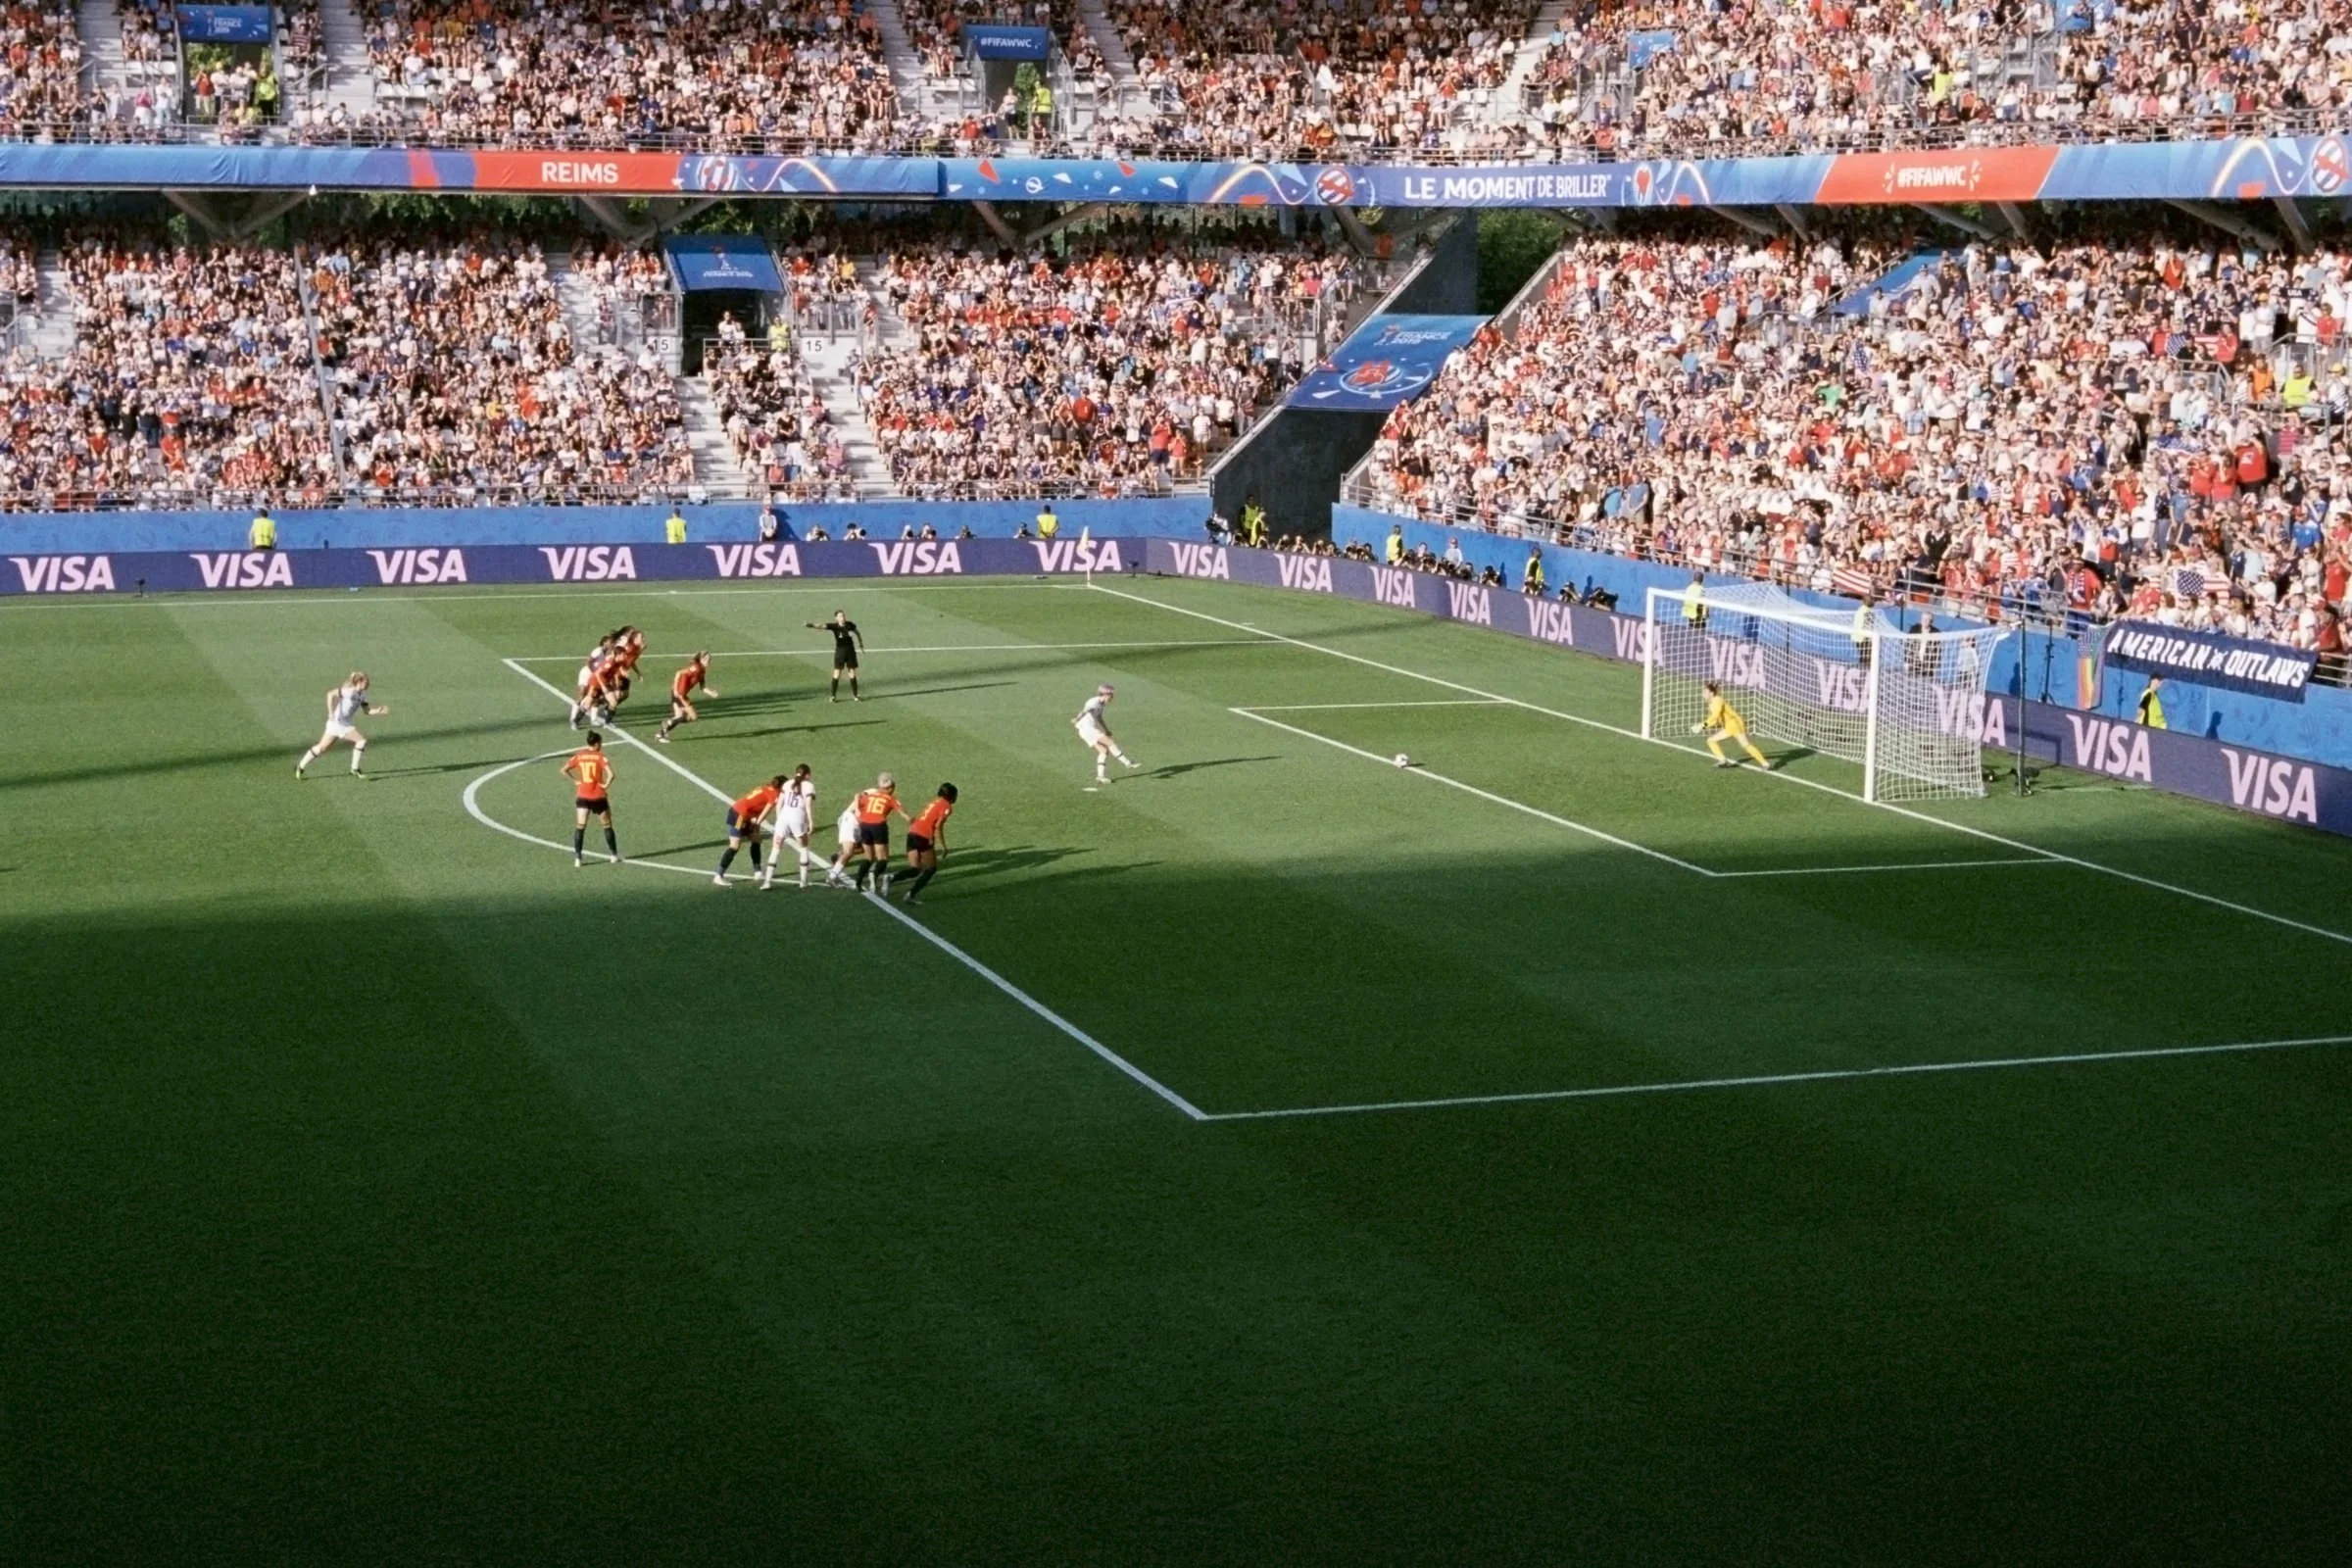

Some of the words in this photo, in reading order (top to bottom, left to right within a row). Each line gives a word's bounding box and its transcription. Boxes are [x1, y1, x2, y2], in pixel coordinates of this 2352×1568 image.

[980, 37, 1032, 48] #FIFAWWC
[541, 161, 619, 183] REIMS
[1404, 176, 1437, 199] LE
[1444, 175, 1536, 200] MOMENT
[1537, 174, 1555, 197] DE
[1897, 165, 1967, 188] #FIFAWWC
[807, 340, 823, 352] 15
[189, 553, 294, 587] VISA
[366, 549, 467, 584] VISA
[538, 547, 636, 579] VISA
[706, 544, 801, 577] VISA
[867, 542, 962, 574] VISA
[1029, 540, 1122, 572] VISA
[1168, 542, 1230, 579] VISA
[1274, 553, 1334, 592] VISA
[9, 557, 115, 591] VISA
[1369, 565, 1415, 608] VISA
[1446, 580, 1491, 625] VISA
[1525, 597, 1573, 645] VISA
[1705, 637, 1765, 689] VISA
[2107, 629, 2212, 670] AMERICAN
[2223, 649, 2311, 688] OUTLAWS
[1931, 684, 2006, 747] VISA
[2067, 713, 2152, 782] VISA
[2221, 748, 2317, 823] VISA
[865, 796, 887, 814] 16
